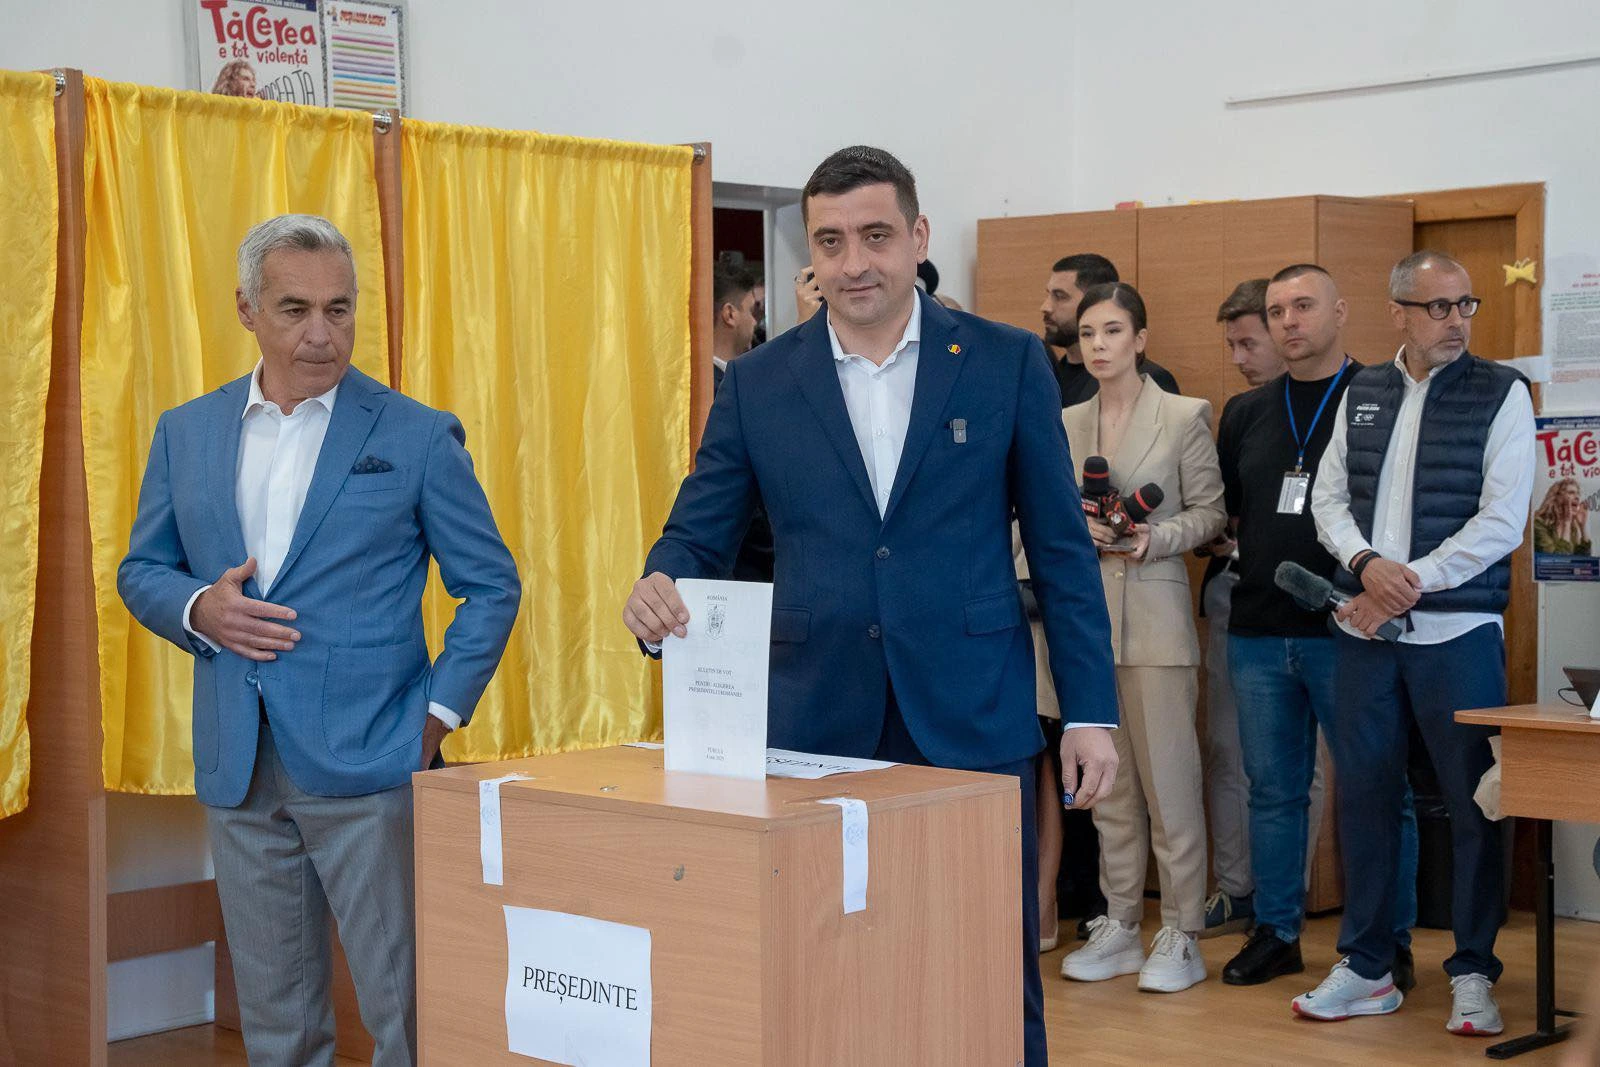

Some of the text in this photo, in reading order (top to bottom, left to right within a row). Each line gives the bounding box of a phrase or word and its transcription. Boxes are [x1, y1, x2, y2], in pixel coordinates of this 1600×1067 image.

[219, 45, 227, 58] e
[231, 41, 249, 59] tot
[1548, 468, 1556, 478] e
[1560, 463, 1576, 477] tot
[523, 966, 638, 1011] PREȘEDINTE
